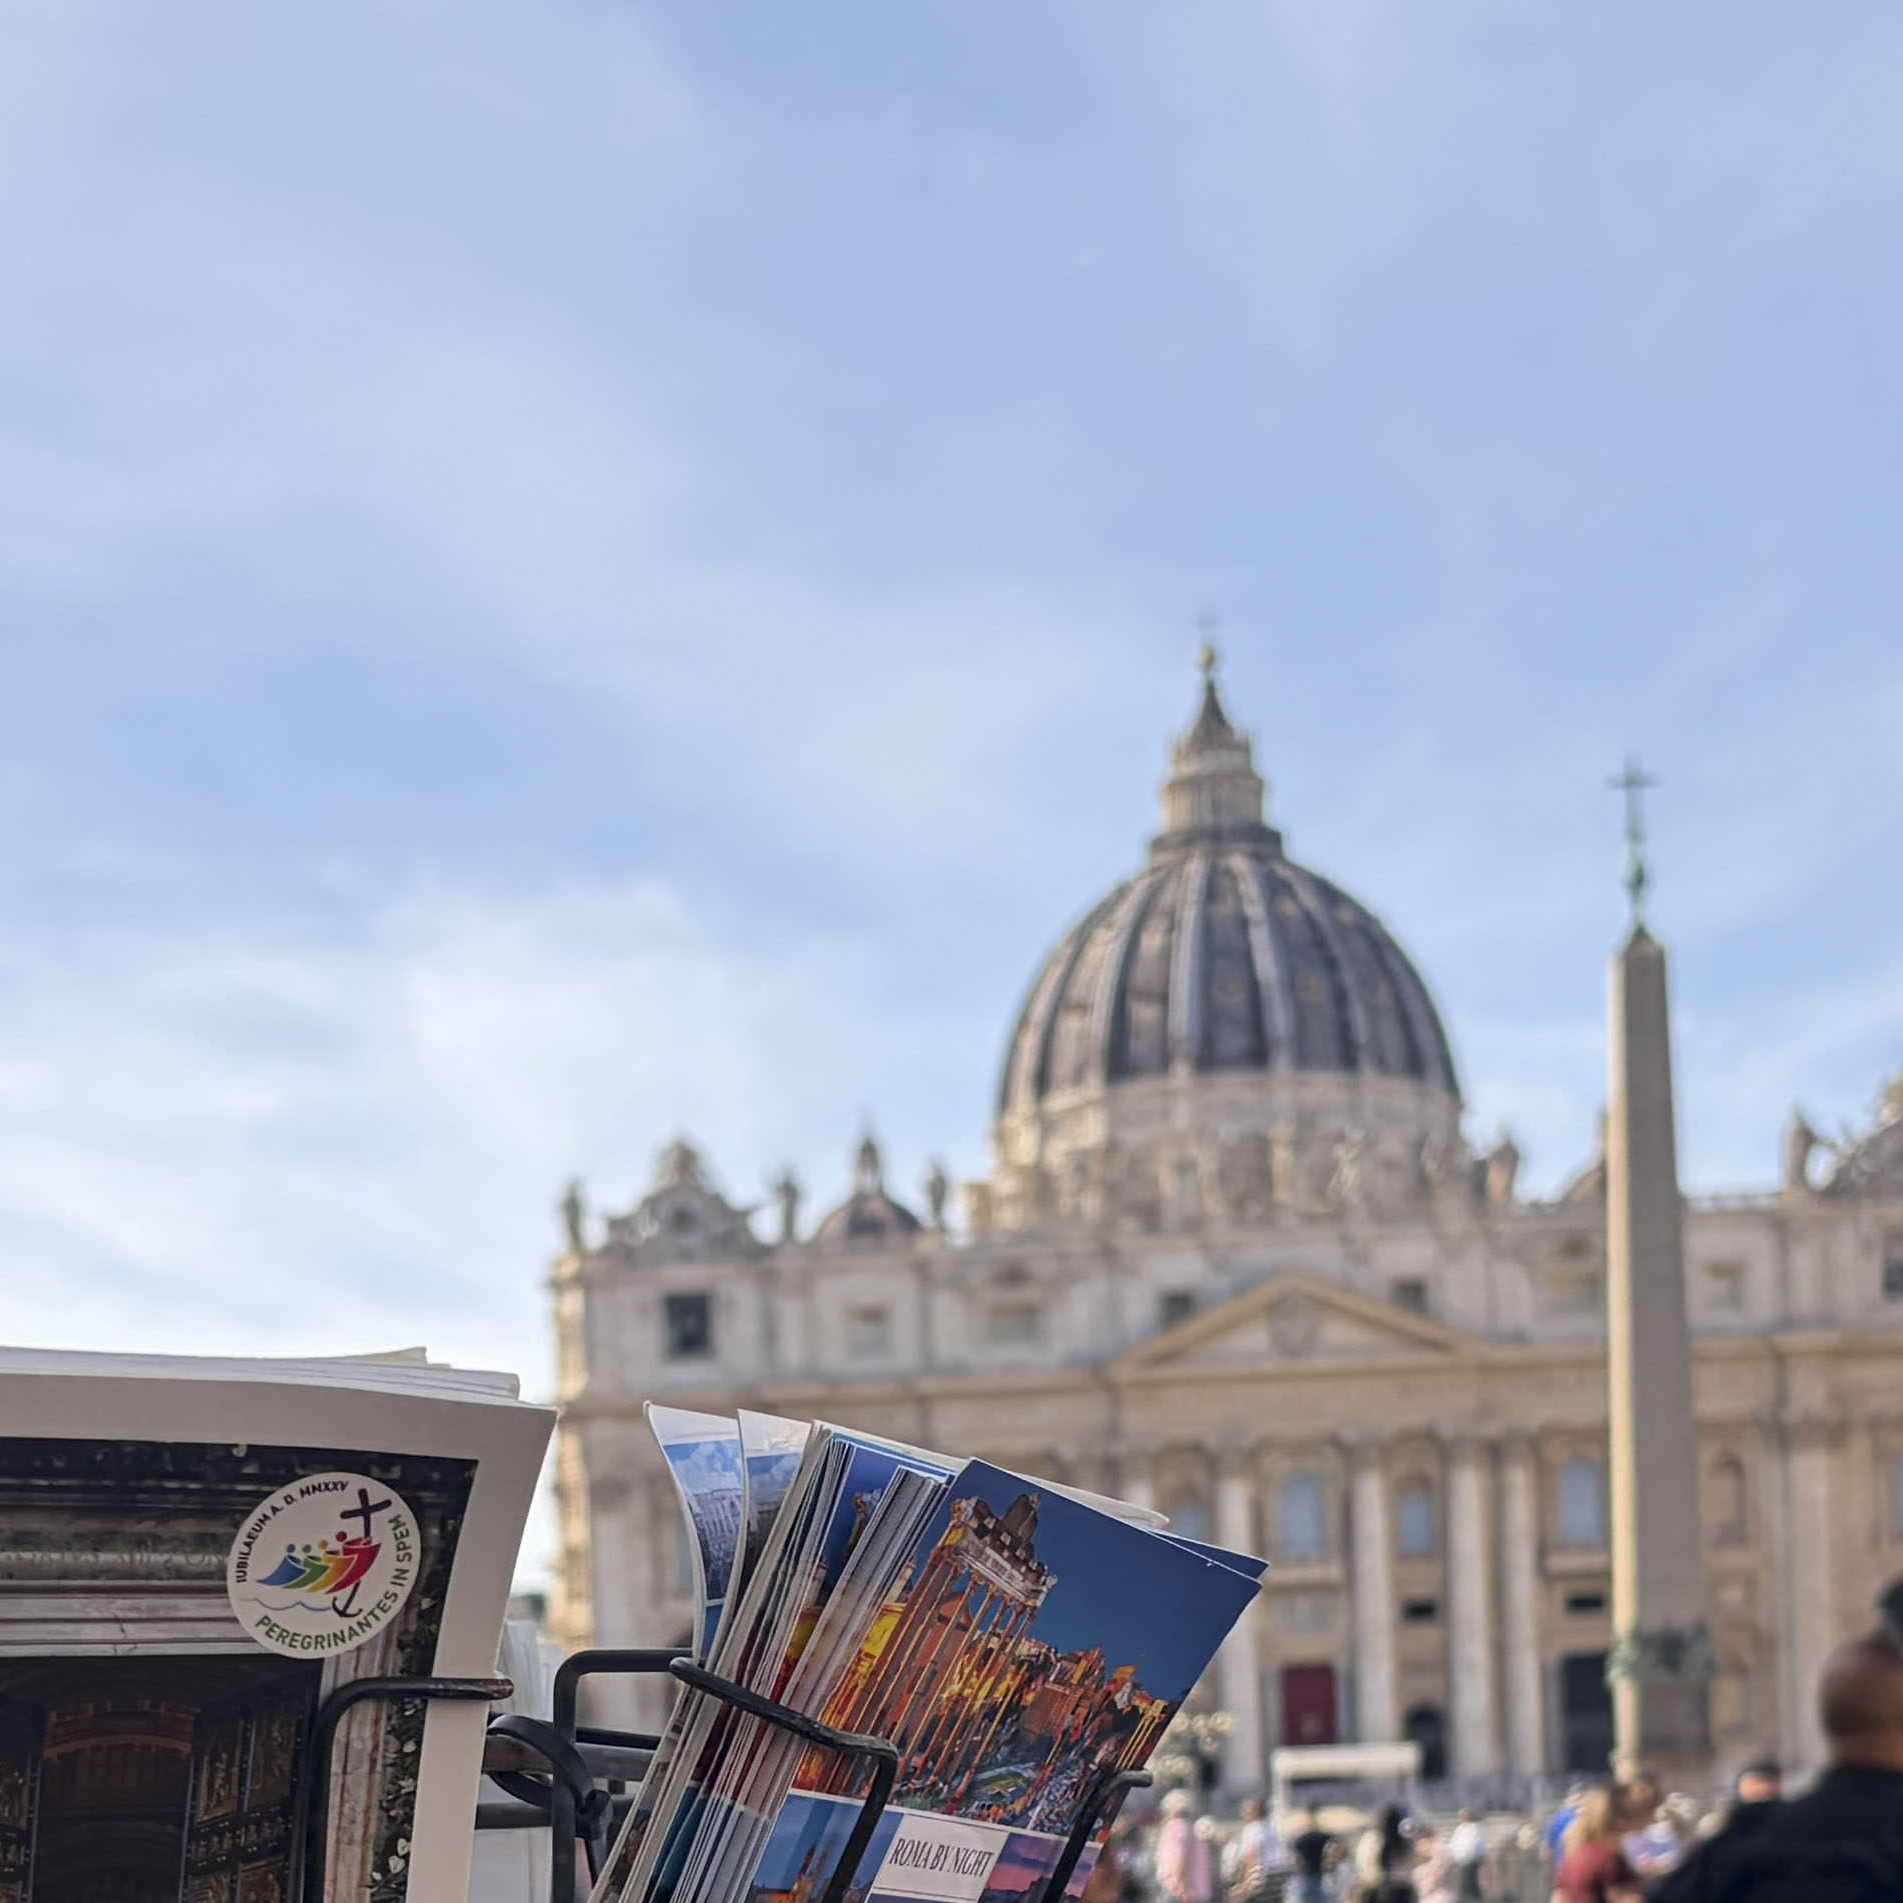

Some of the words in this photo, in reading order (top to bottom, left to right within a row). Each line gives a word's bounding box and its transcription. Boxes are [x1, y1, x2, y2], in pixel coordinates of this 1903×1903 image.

[236, 1513, 271, 1583] IUBILAEUM
[270, 1506, 284, 1516] A.
[283, 1494, 298, 1505] D.
[299, 1481, 349, 1498] MMXXV
[388, 1514, 412, 1562] SPEM
[390, 1568, 409, 1587] IN
[255, 1591, 398, 1650] PEREGRINANTES
[889, 1838, 934, 1869] ROMA
[929, 1844, 954, 1872] BY
[947, 1847, 995, 1878] NIGHT
